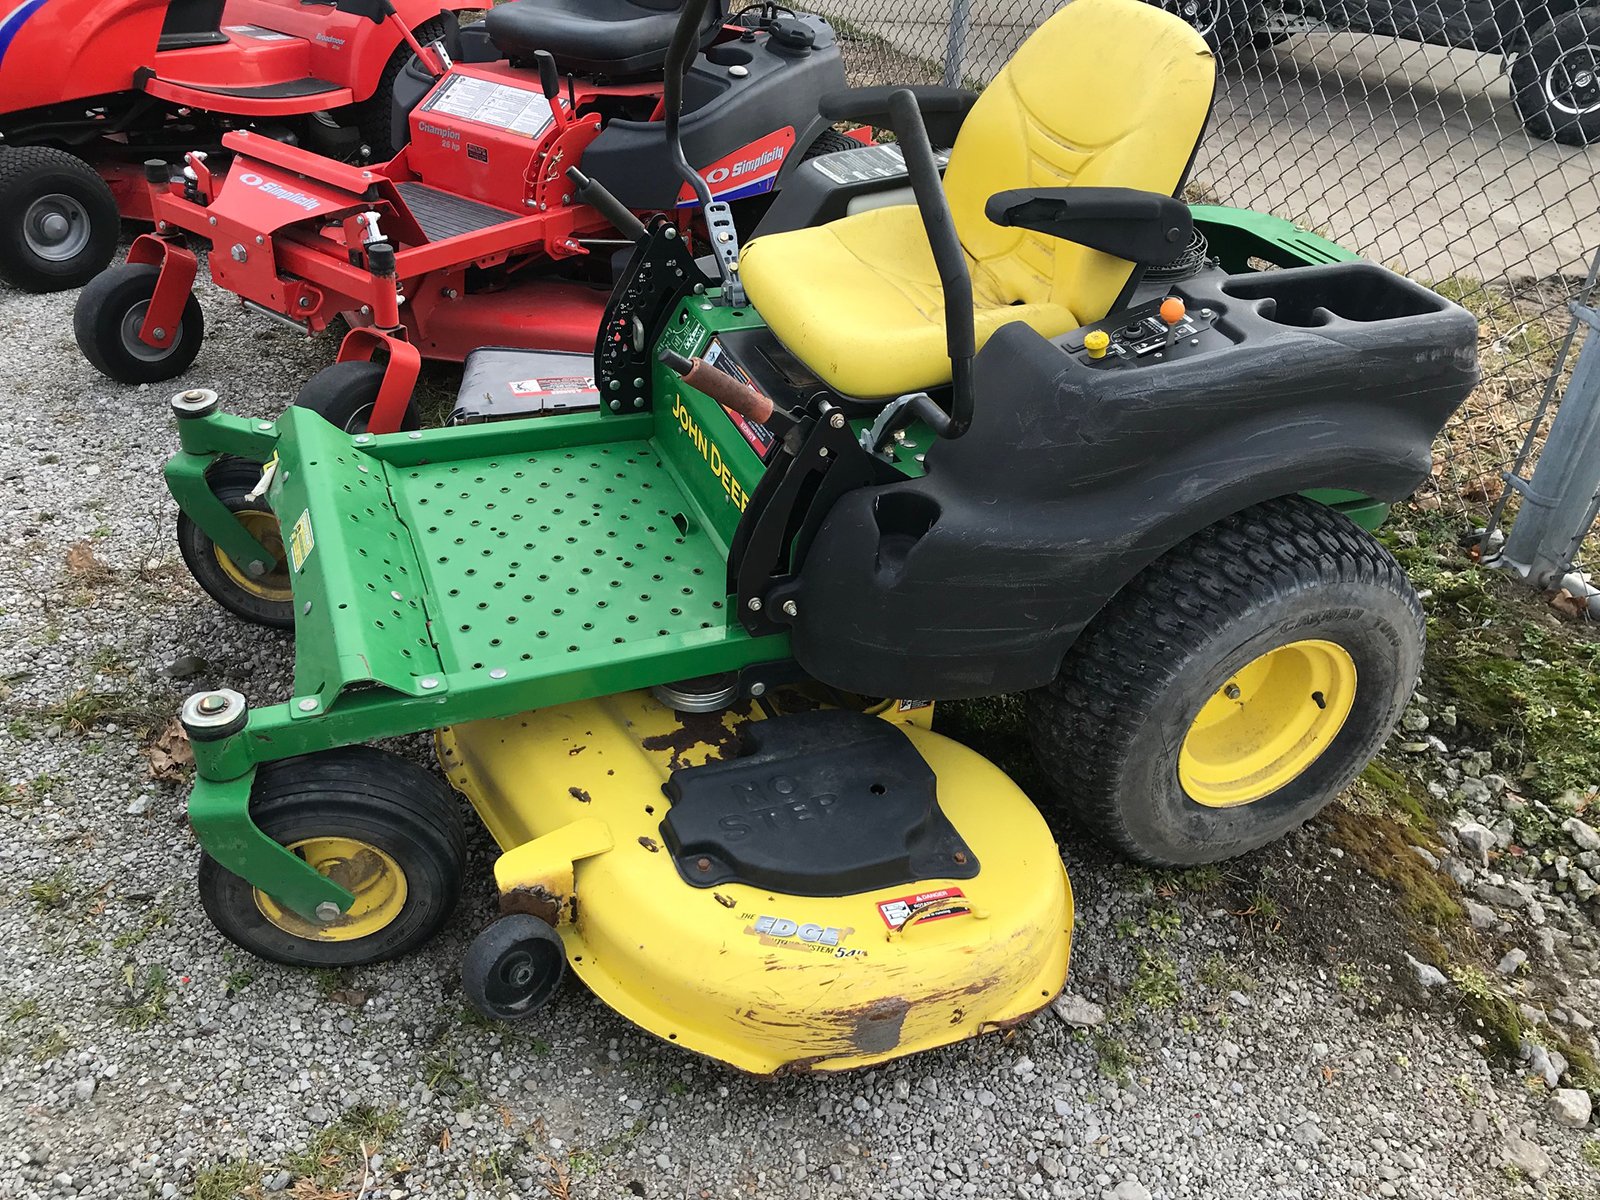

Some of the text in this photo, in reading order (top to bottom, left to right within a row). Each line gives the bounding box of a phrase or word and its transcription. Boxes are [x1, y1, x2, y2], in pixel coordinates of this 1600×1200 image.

[418, 121, 461, 140] Champion
[452, 142, 461, 152] hp
[731, 146, 785, 178] Simplicity
[258, 182, 321, 211] Simplicity
[672, 393, 751, 514] JOHN DEER
[731, 775, 798, 807] NO
[718, 792, 840, 841] STEP
[922, 890, 948, 900] DANGER
[740, 912, 756, 920] THE
[754, 915, 841, 946] EDGE
